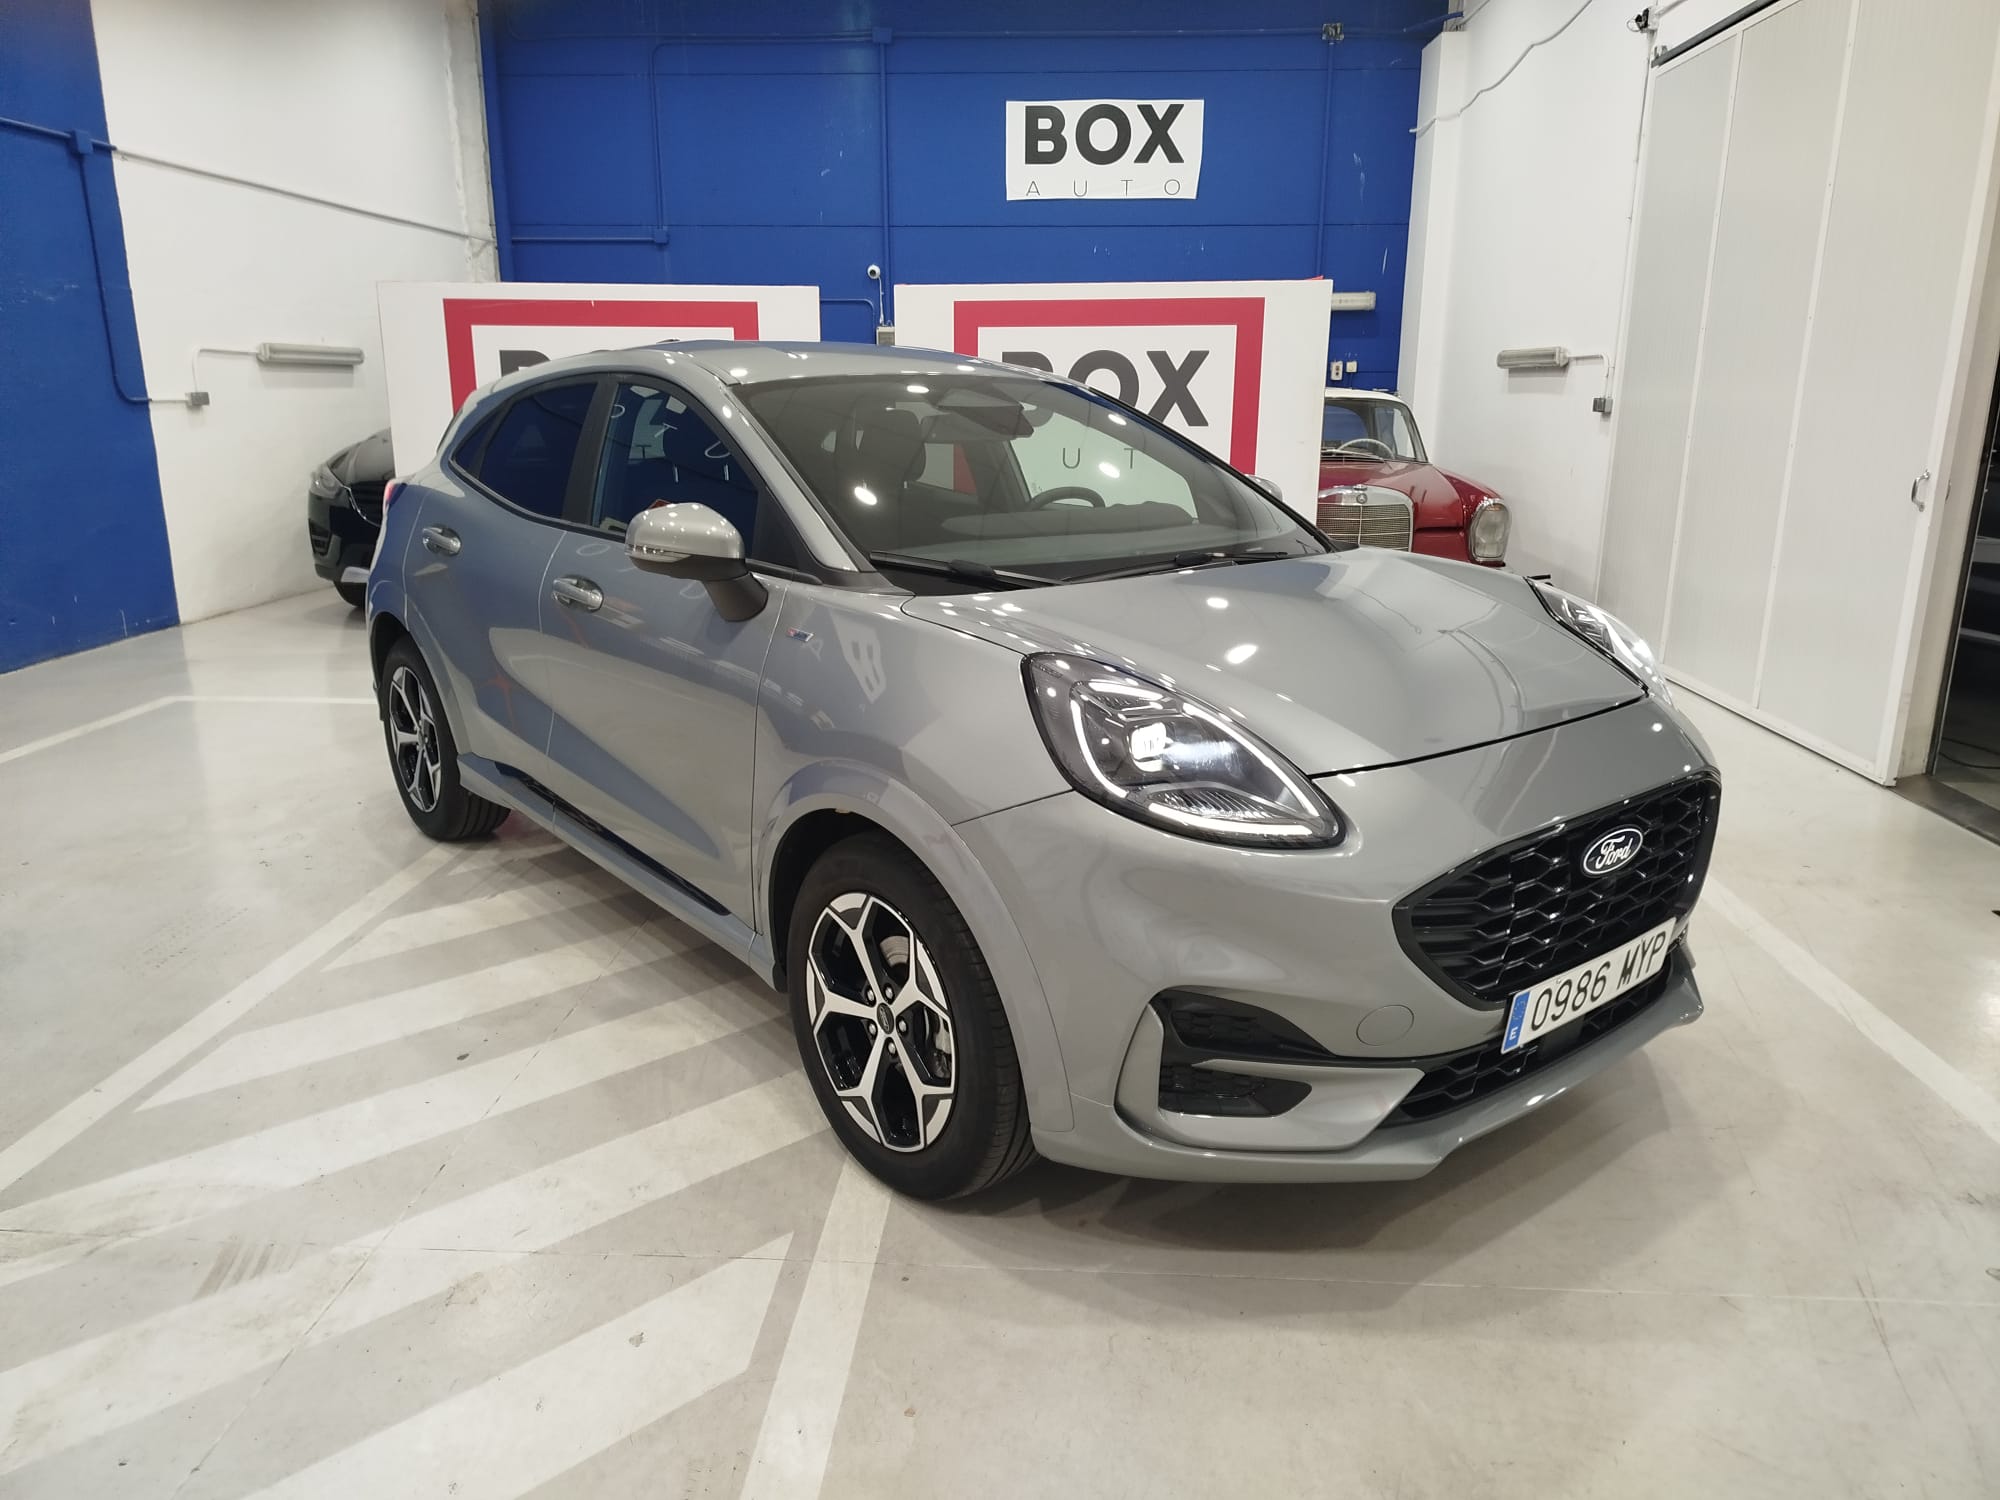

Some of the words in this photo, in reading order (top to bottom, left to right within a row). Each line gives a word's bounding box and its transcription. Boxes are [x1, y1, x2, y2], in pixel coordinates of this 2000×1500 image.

[1025, 104, 1185, 165] BOX
[1025, 179, 1181, 198] AUTO
[1595, 834, 1634, 870] Ford
[1531, 960, 1611, 1032] 0986
[1616, 930, 1667, 990] MYP
[1509, 1026, 1519, 1041] E
